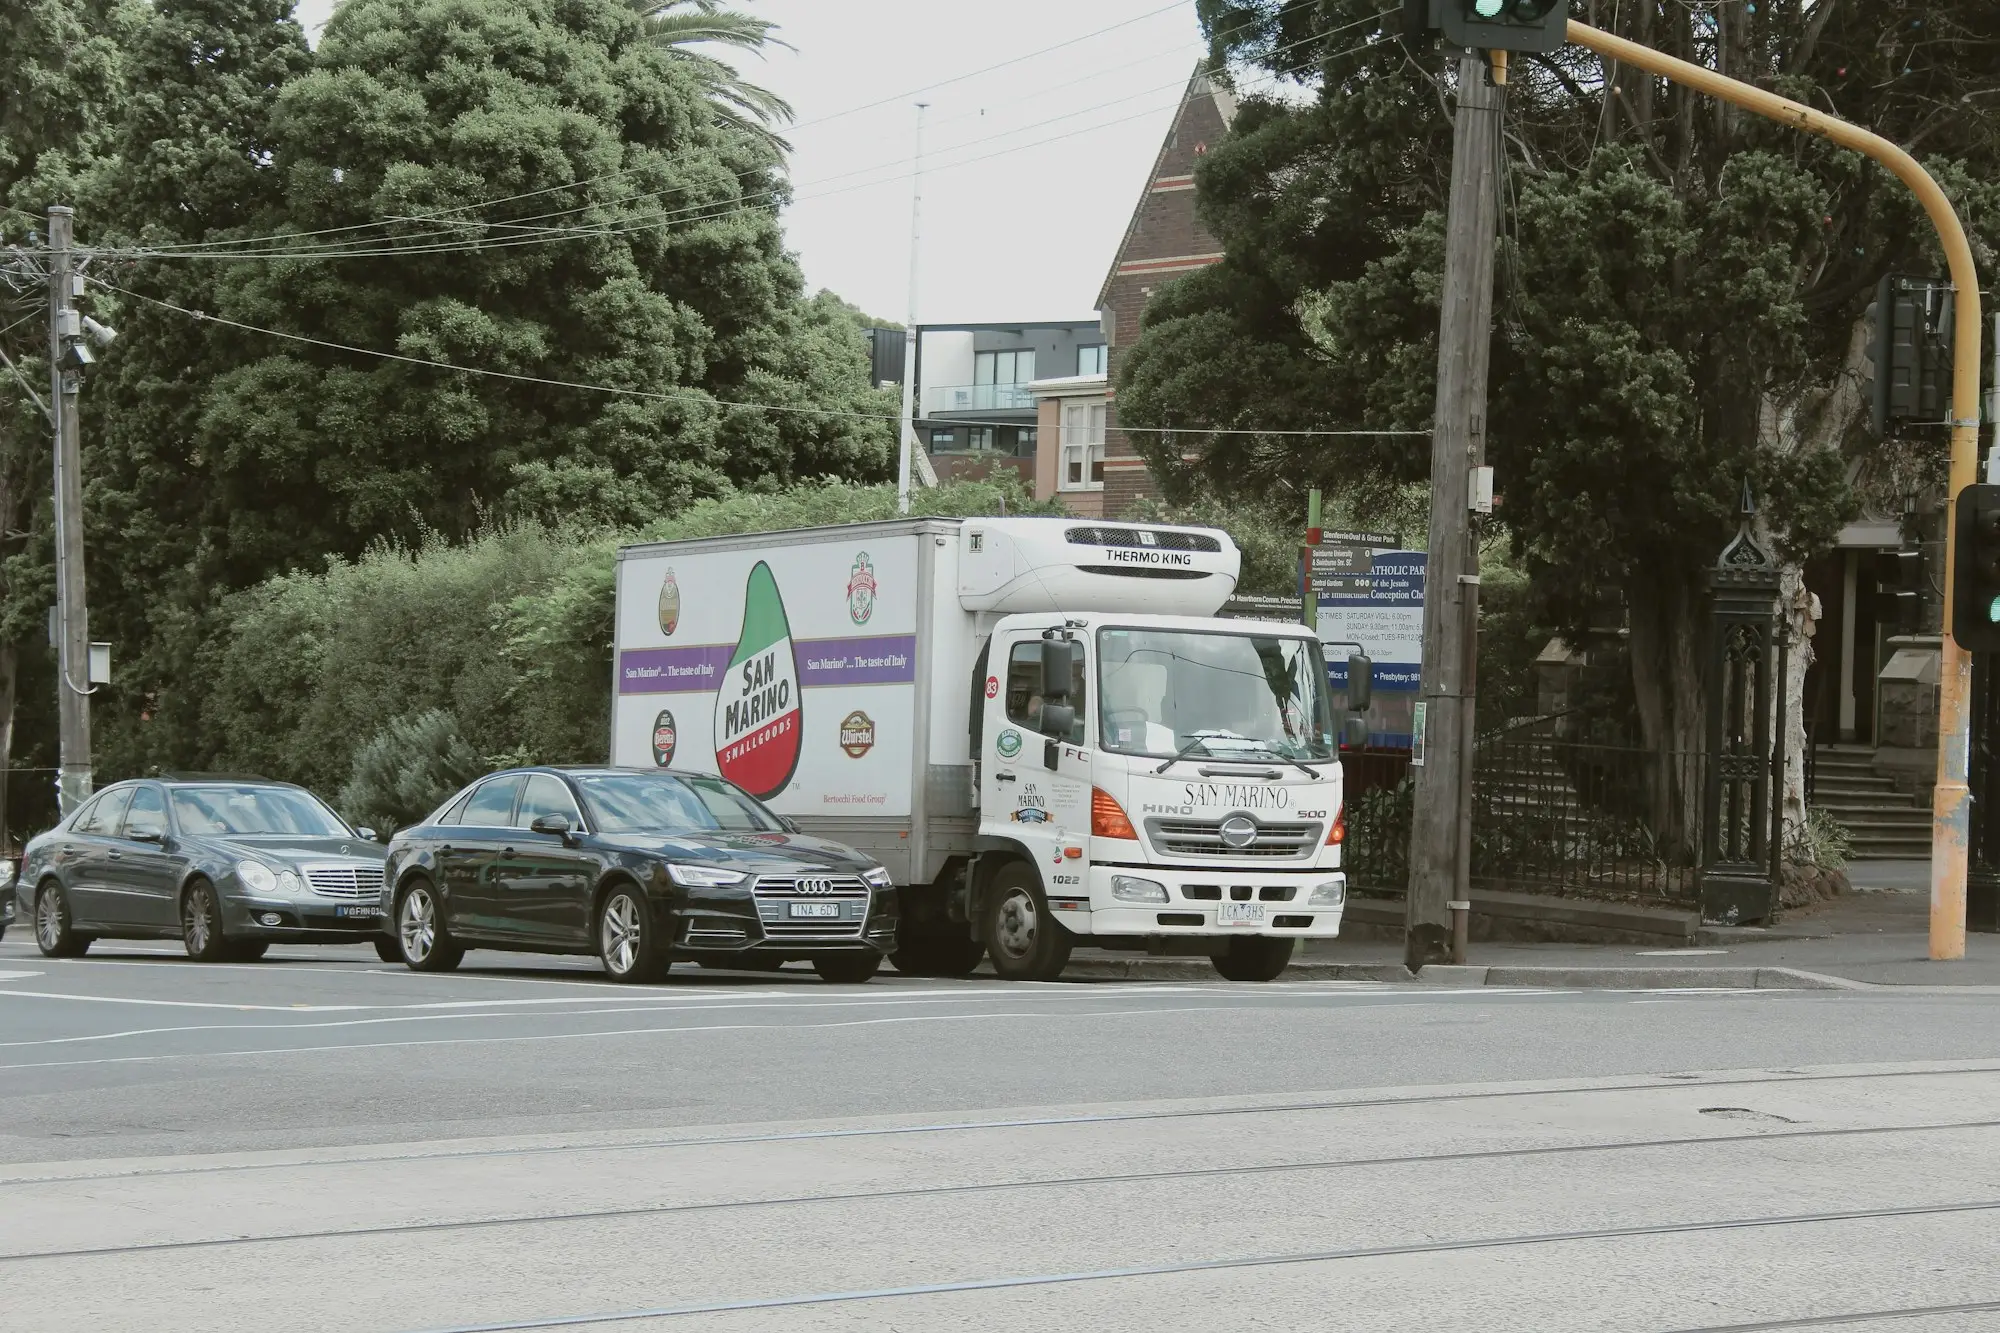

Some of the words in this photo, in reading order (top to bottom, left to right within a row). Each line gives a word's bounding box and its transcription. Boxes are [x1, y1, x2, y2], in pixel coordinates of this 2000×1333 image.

[1323, 531, 1348, 540] Glenferrie
[1349, 533, 1361, 541] Oval
[1367, 534, 1382, 543] Grace
[1383, 535, 1395, 543] Park
[1106, 549, 1160, 563] THERMO
[1162, 553, 1191, 565] KING
[1333, 550, 1353, 559] University
[1327, 579, 1344, 587] Gardens
[1372, 579, 1379, 587] of
[1380, 579, 1389, 587] the
[1389, 579, 1409, 589] Jesuits
[1236, 595, 1262, 603] Hawthorn
[1262, 596, 1280, 604] Comm.
[1280, 597, 1302, 605] Precinct
[1370, 590, 1410, 602] Conception
[1325, 612, 1343, 620] TIMES
[1346, 612, 1374, 621] SATURDAY
[808, 658, 820, 671] San
[855, 656, 867, 668] The
[868, 657, 884, 667] taste
[884, 656, 893, 667] of
[892, 654, 907, 669] Italy
[625, 668, 638, 678] San
[668, 665, 680, 677] The
[680, 665, 694, 676] taste
[694, 664, 703, 675] of
[701, 663, 715, 678] Italy
[742, 652, 775, 697] SAN
[1379, 672, 1410, 683] Presbytery:
[985, 681, 998, 694] 83
[725, 679, 790, 740] MARINO
[726, 718, 792, 763] SMALLGOODS
[841, 729, 873, 745] Würstel
[1064, 747, 1089, 763] FC
[1024, 783, 1037, 794] SAN
[823, 794, 851, 804] Bertocchi
[851, 795, 866, 803] Food
[1018, 795, 1045, 807] MARINO
[1183, 783, 1219, 807] SAN
[1224, 785, 1288, 809] MARINO
[1142, 803, 1194, 815] HINO
[1297, 809, 1327, 819] 500
[1052, 875, 1081, 885] 1022
